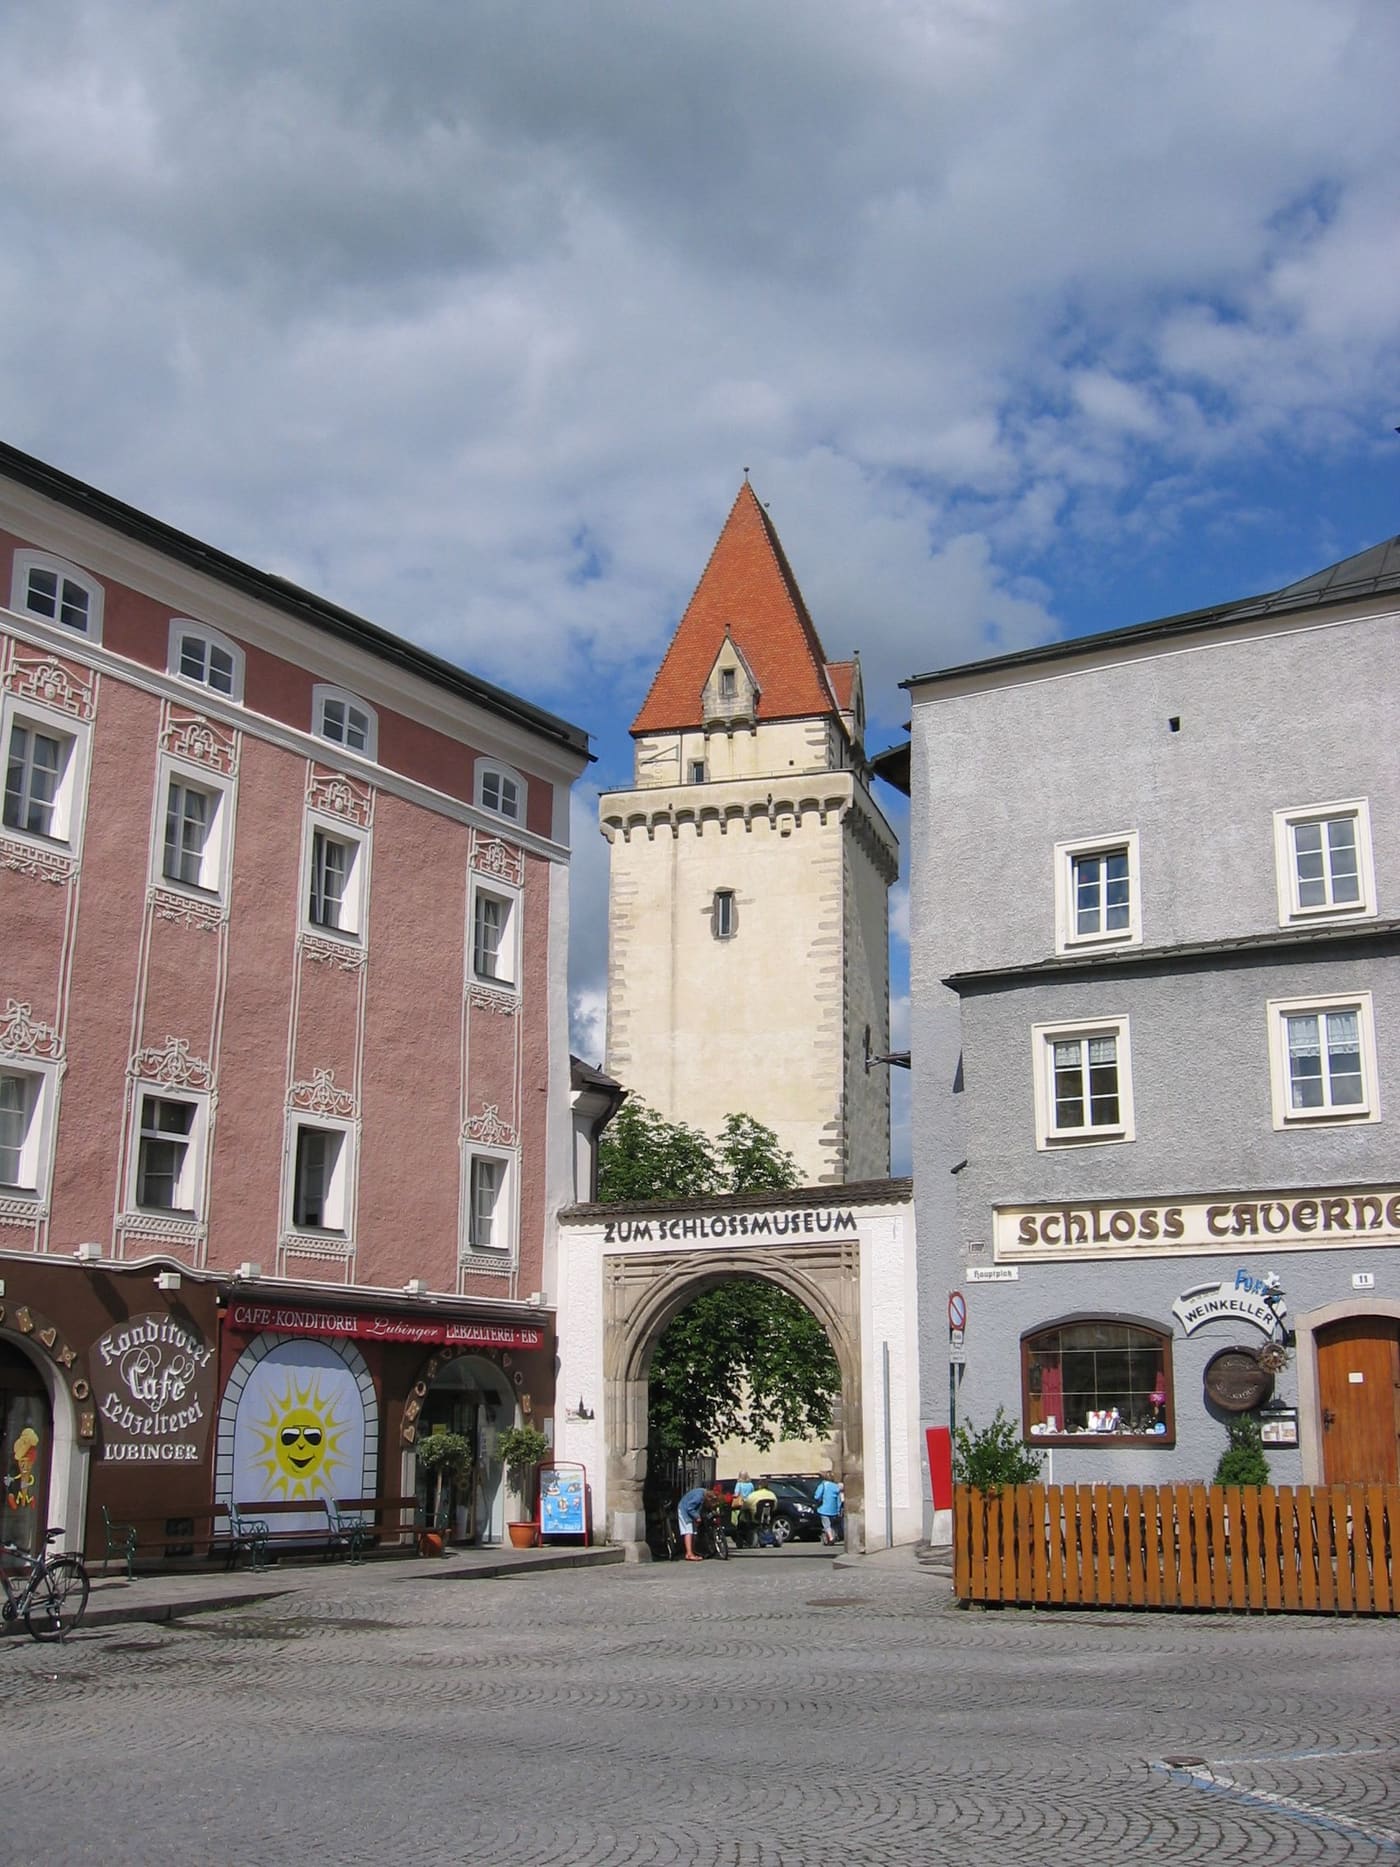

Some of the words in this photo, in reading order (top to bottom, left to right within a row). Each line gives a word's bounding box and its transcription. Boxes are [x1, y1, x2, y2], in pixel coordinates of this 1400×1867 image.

[603, 1221, 653, 1243] ZUM
[659, 1211, 857, 1240] SCHLOSSMUSEUM
[1358, 1275, 1368, 1283] 11
[275, 1311, 358, 1332] KONDITOREI
[367, 1316, 439, 1342] Lubinger
[446, 1324, 514, 1343] LEBZELTEREI
[521, 1330, 538, 1344] EIS
[1185, 1299, 1274, 1325] WEINKELLER
[100, 1316, 215, 1367] Konditorei
[101, 1392, 204, 1436] Lebzelterei
[104, 1443, 199, 1461] LUBINGER
